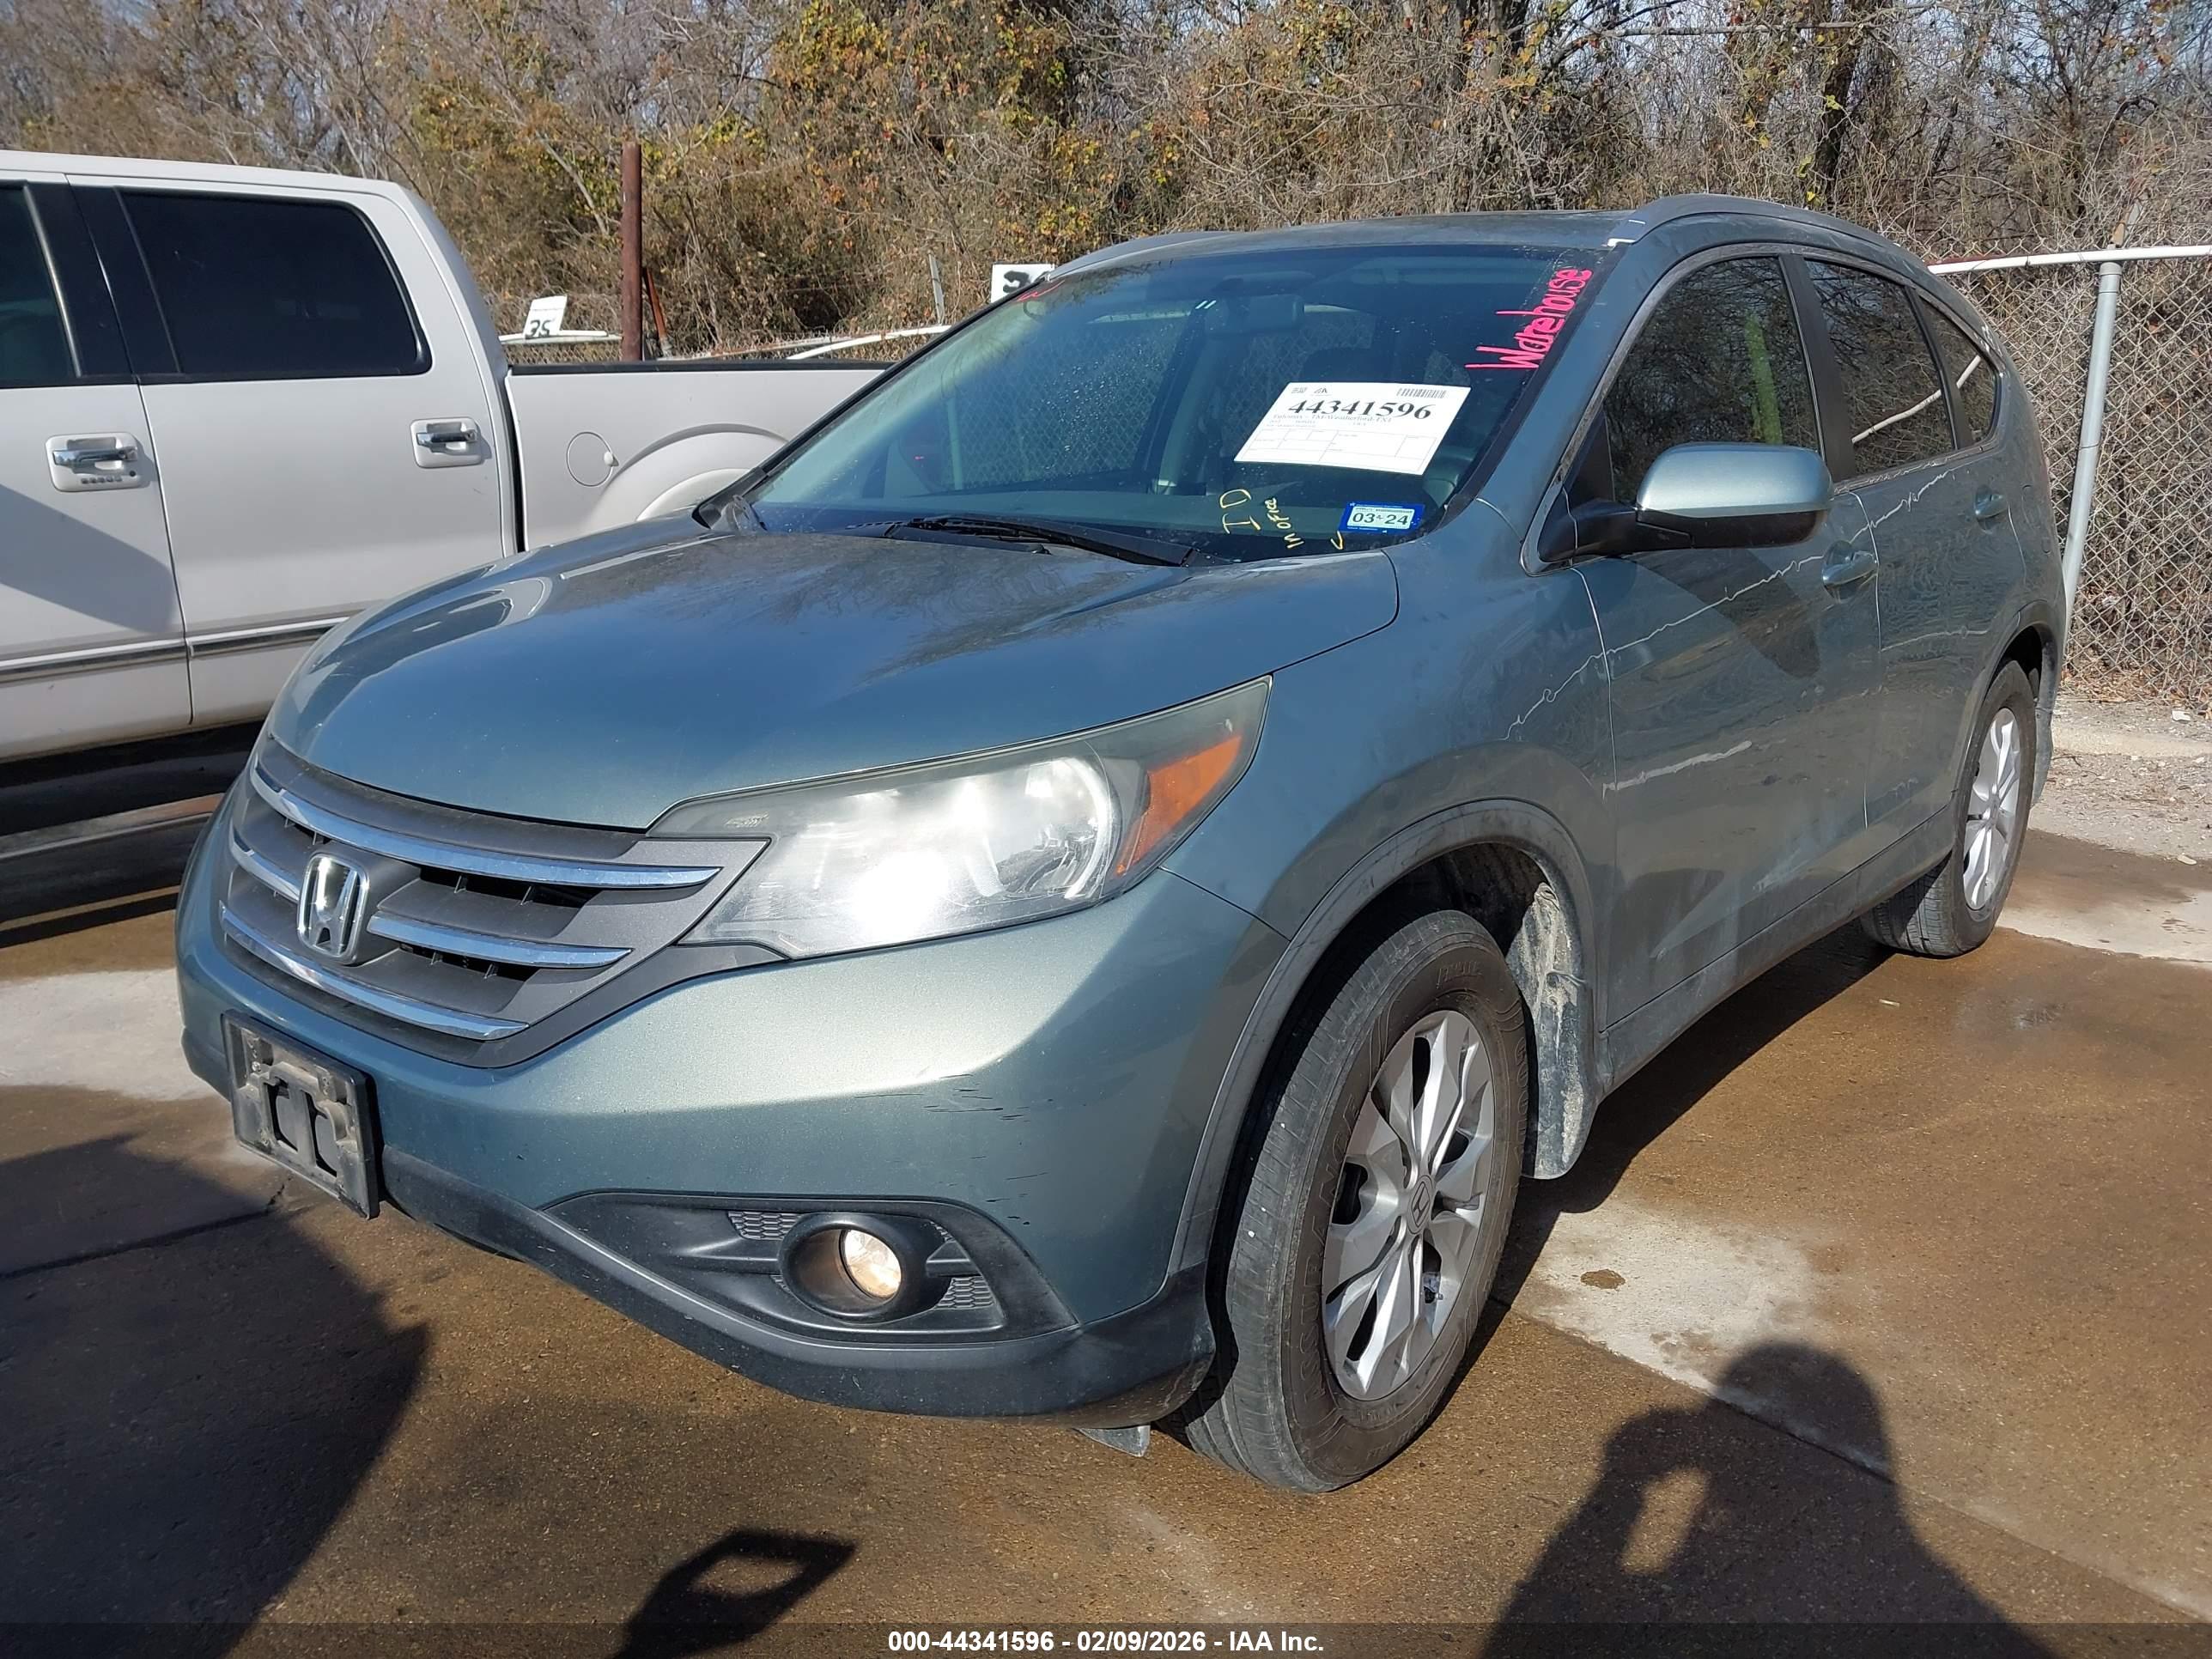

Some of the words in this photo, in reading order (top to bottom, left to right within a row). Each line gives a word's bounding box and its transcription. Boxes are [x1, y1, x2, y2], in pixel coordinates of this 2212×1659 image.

[1465, 269, 1593, 368] Warehouse
[1289, 399, 1435, 420] 44341596
[1219, 489, 1261, 534] ID
[1352, 513, 1376, 523] 03
[1384, 514, 1409, 525] 24
